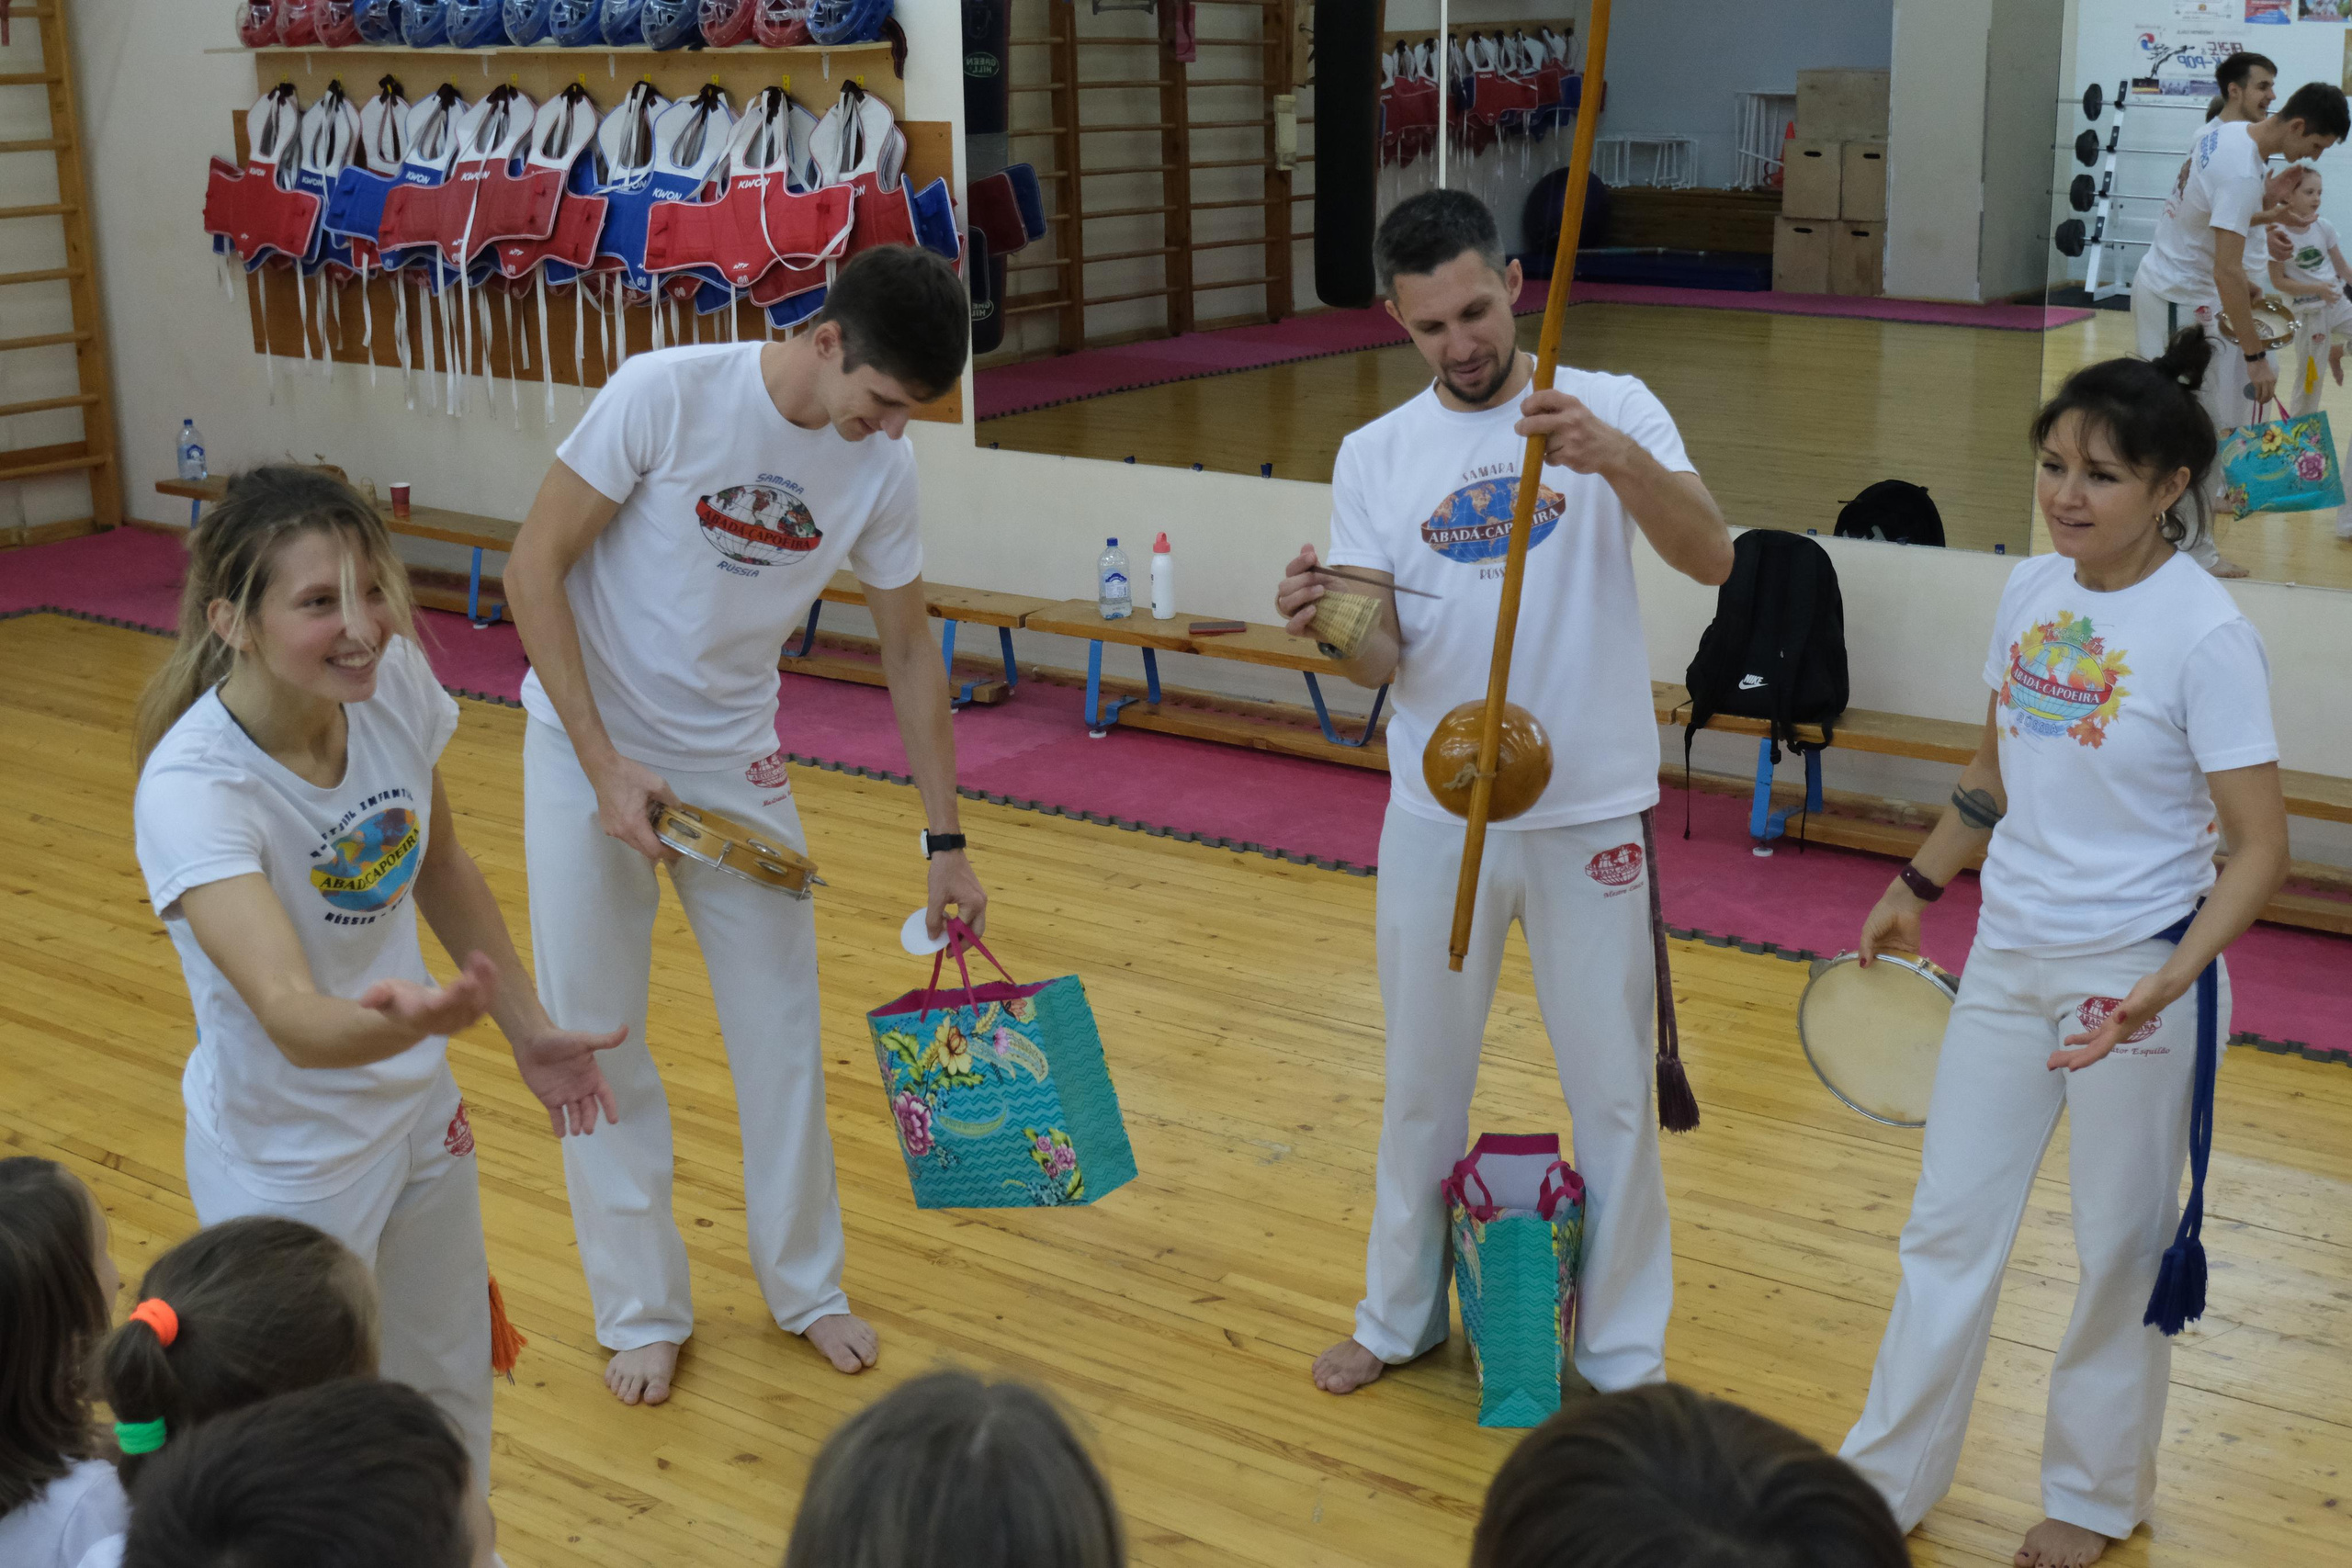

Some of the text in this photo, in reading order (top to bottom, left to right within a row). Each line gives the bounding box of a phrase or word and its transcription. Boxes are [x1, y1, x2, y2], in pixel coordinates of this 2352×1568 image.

[249, 167, 266, 177] KWON
[405, 171, 431, 185] KWON
[301, 176, 323, 187] KWON
[652, 187, 683, 200] KWON
[1462, 462, 1514, 483] SAMARA
[755, 472, 805, 495] SAMARA
[1428, 506, 1559, 543] ABADÁ-CAPIRA
[1742, 673, 1764, 684] NIKE
